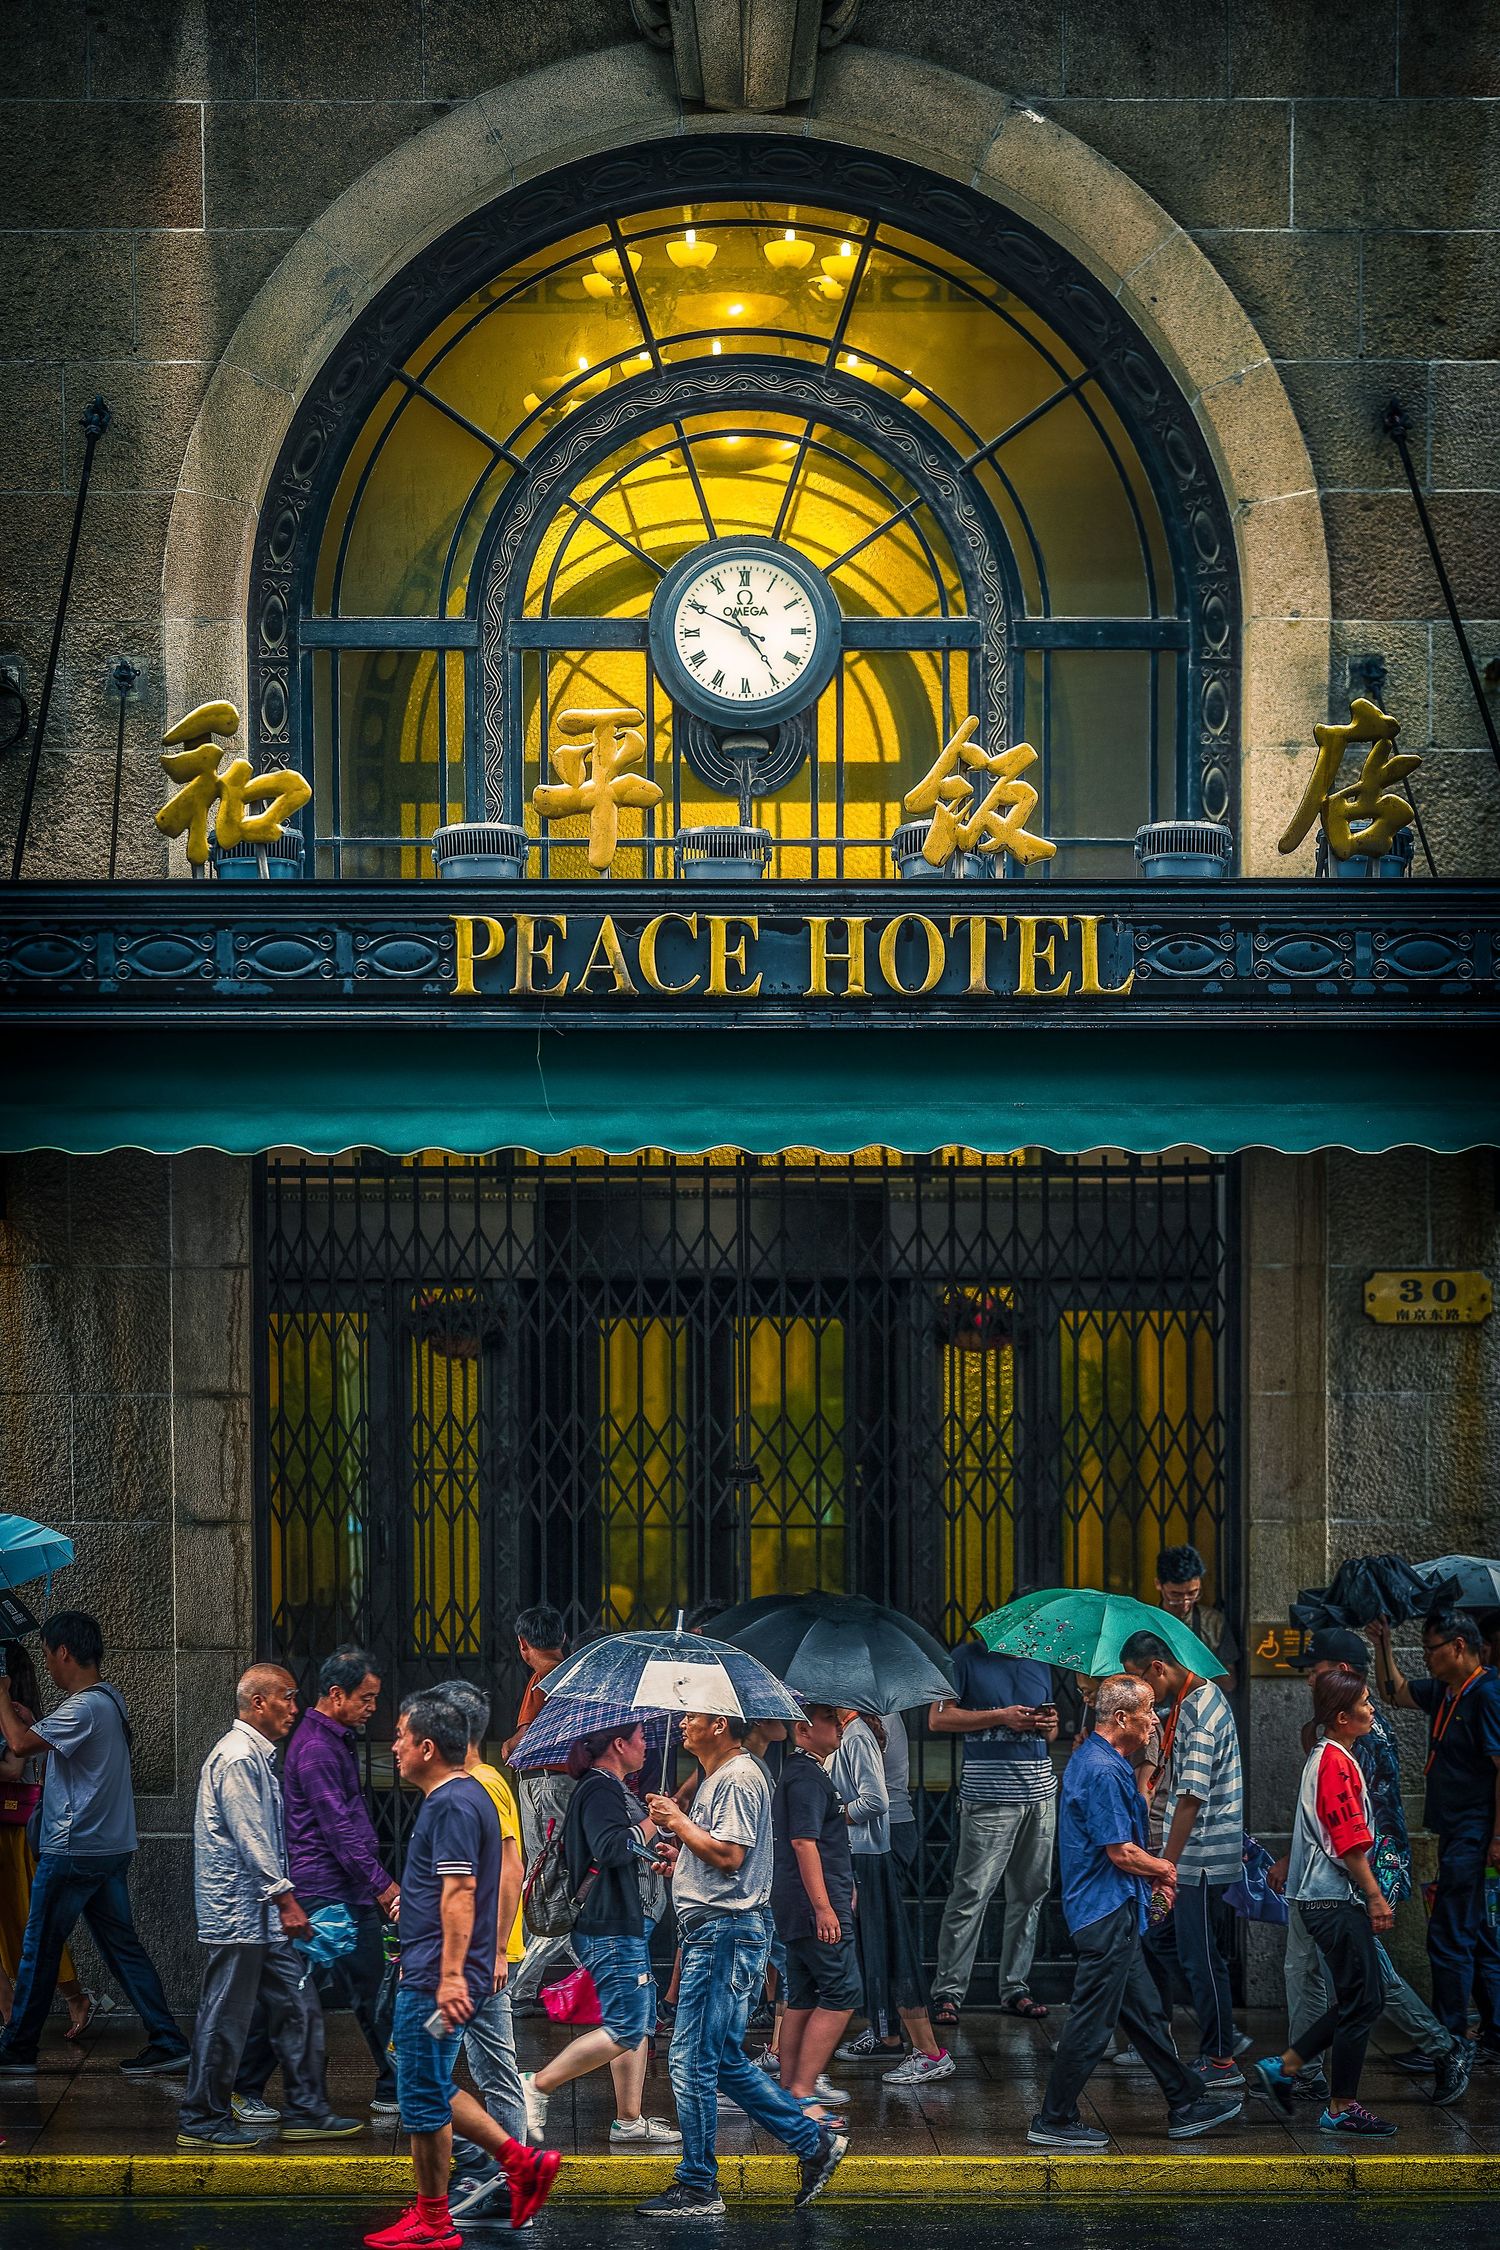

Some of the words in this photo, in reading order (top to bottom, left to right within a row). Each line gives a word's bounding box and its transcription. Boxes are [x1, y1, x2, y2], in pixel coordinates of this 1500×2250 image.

[723, 606, 768, 616] OMEGA
[448, 912, 763, 997] PEACE
[801, 913, 1136, 997] HOTEL
[1399, 1279, 1457, 1303] 30
[1396, 1308, 1460, 1320] 南京东路
